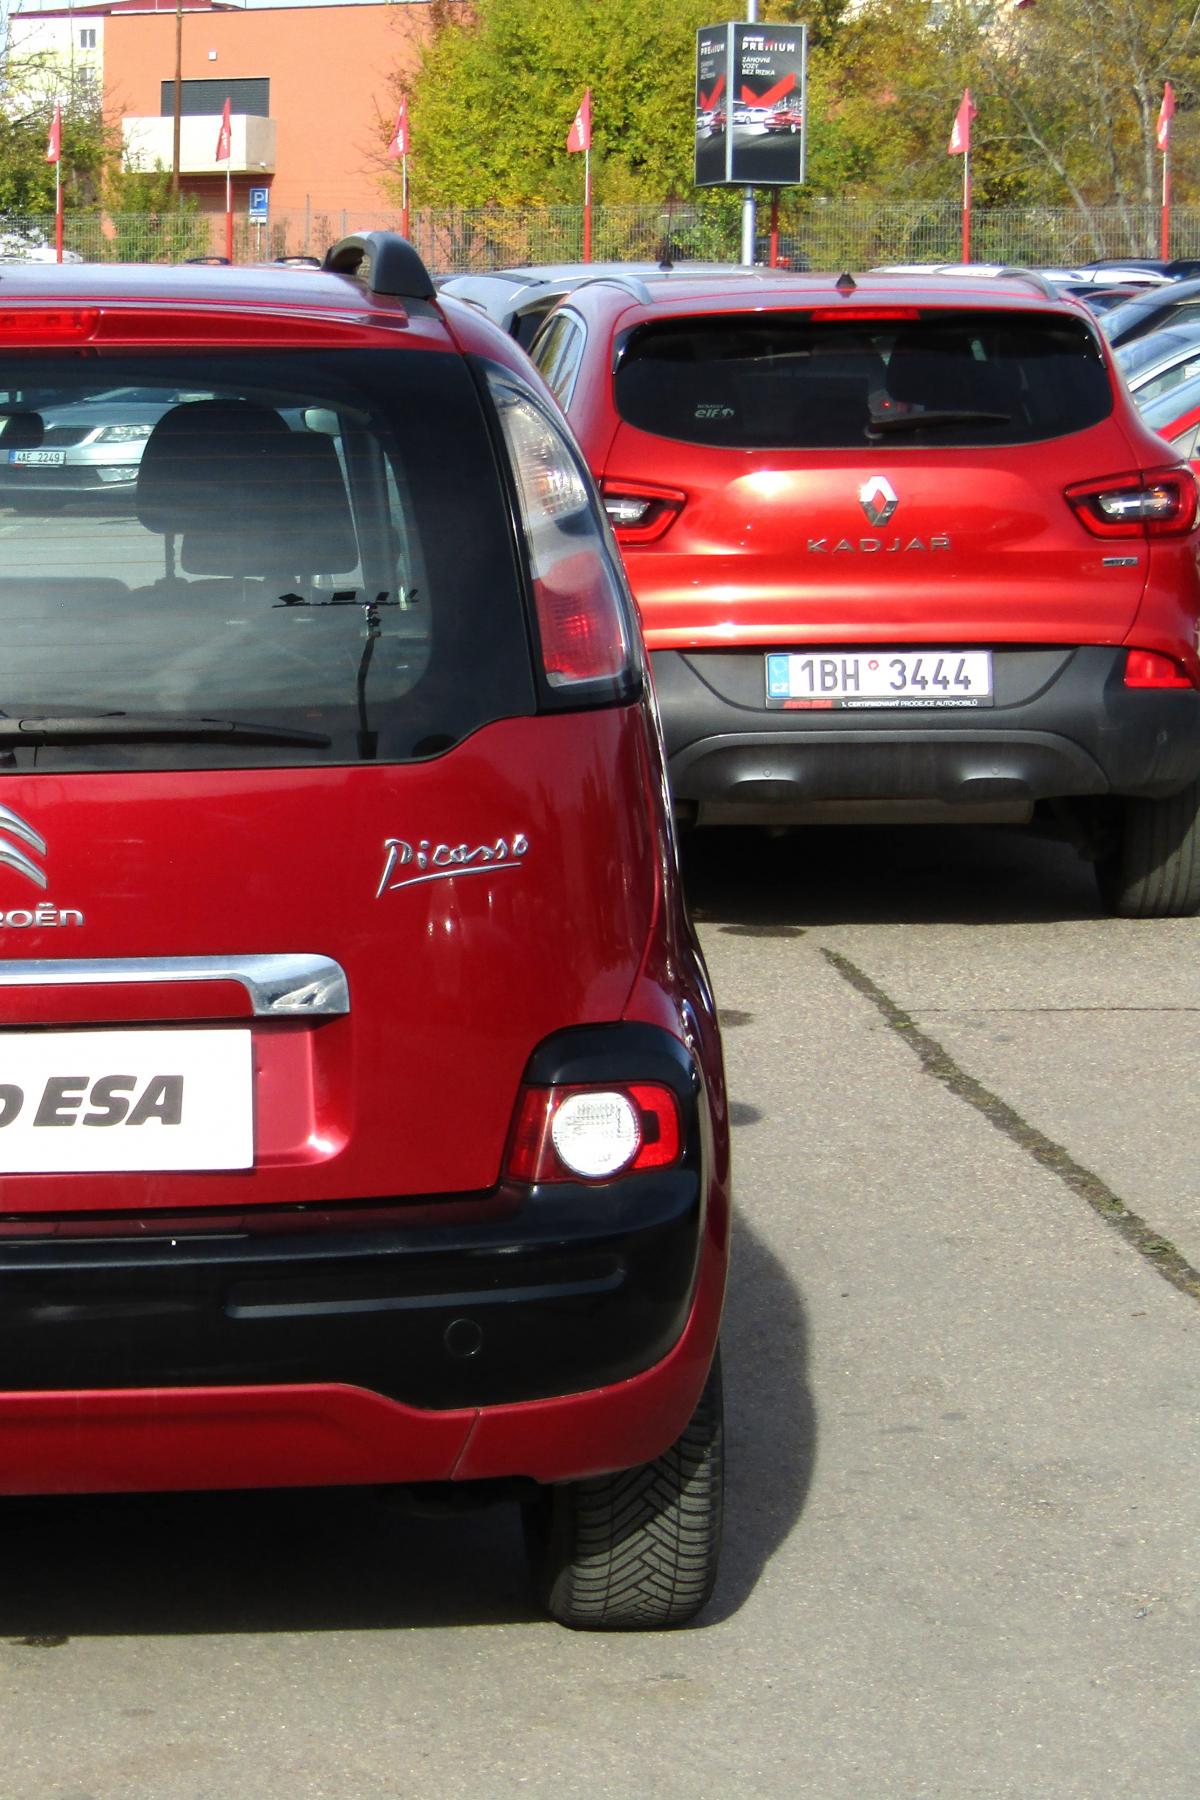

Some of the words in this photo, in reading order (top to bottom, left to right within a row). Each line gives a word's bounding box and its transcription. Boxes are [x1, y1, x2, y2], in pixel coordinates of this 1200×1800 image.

[742, 41, 795, 52] PREMIUM
[254, 191, 265, 207] P
[807, 536, 951, 553] KADJAR
[801, 658, 860, 692] 1BH
[889, 658, 972, 691] 3444
[375, 834, 529, 899] Picasso
[33, 1074, 184, 1127] ESA
